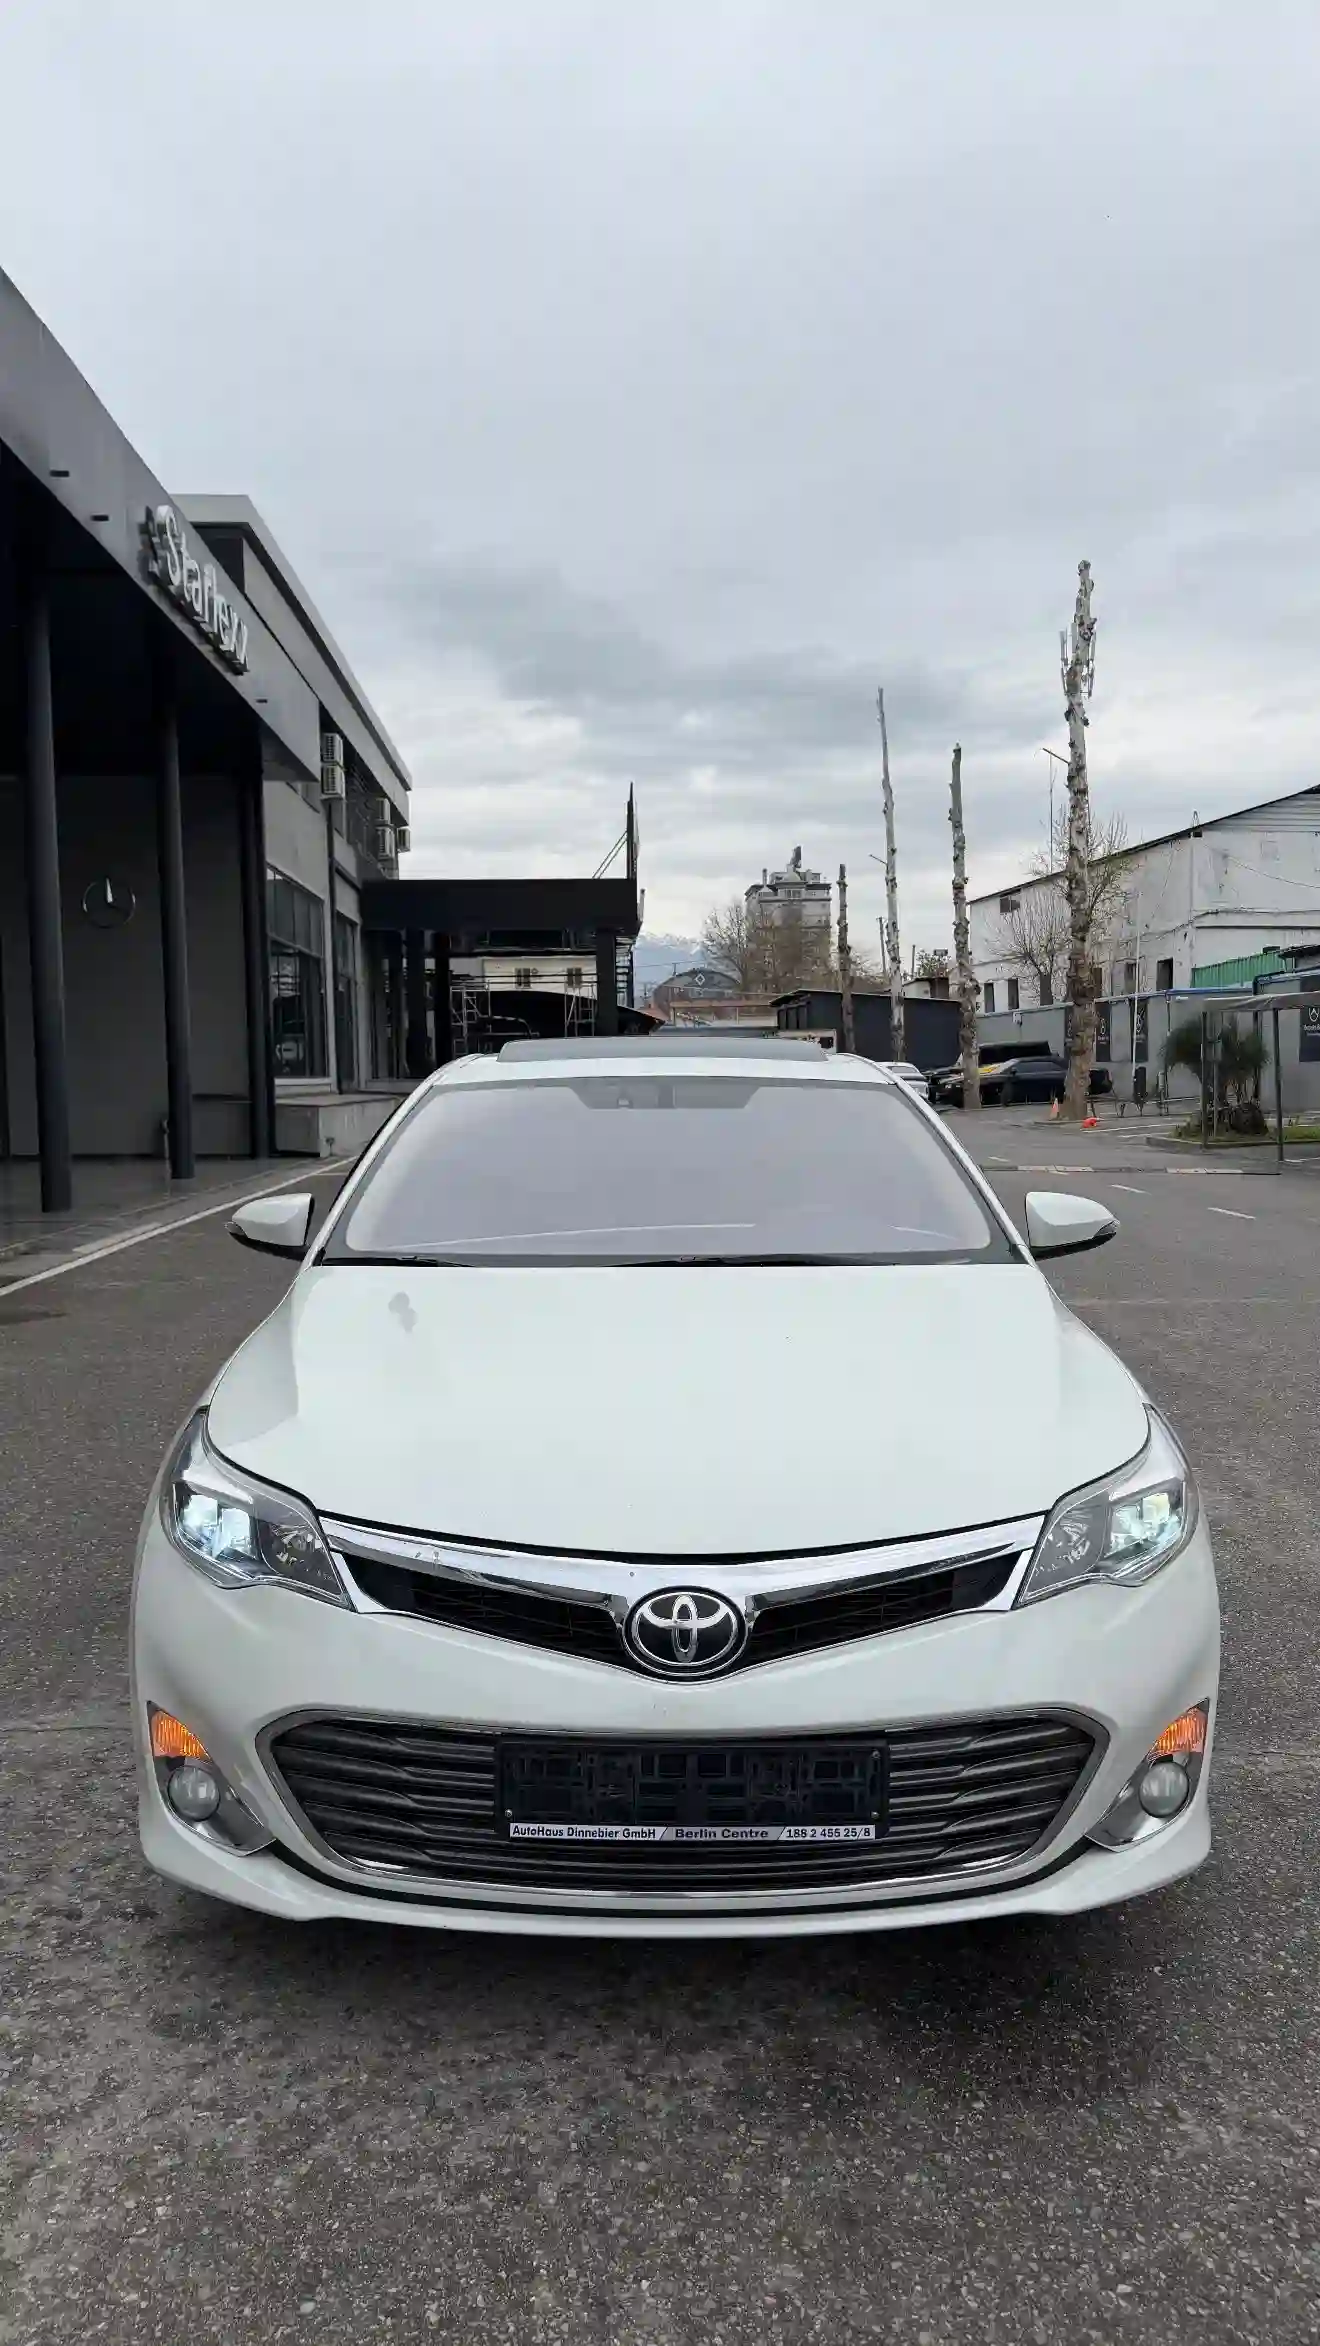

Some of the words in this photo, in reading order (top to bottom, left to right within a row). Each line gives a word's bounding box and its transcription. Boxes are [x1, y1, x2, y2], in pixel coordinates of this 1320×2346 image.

[512, 1825, 564, 1837] AutoHaus
[567, 1826, 620, 1838] Dinnebier
[622, 1828, 656, 1839] GmbH
[675, 1828, 717, 1839] Berlin
[721, 1828, 769, 1838] Centre
[810, 1828, 818, 1838] 2
